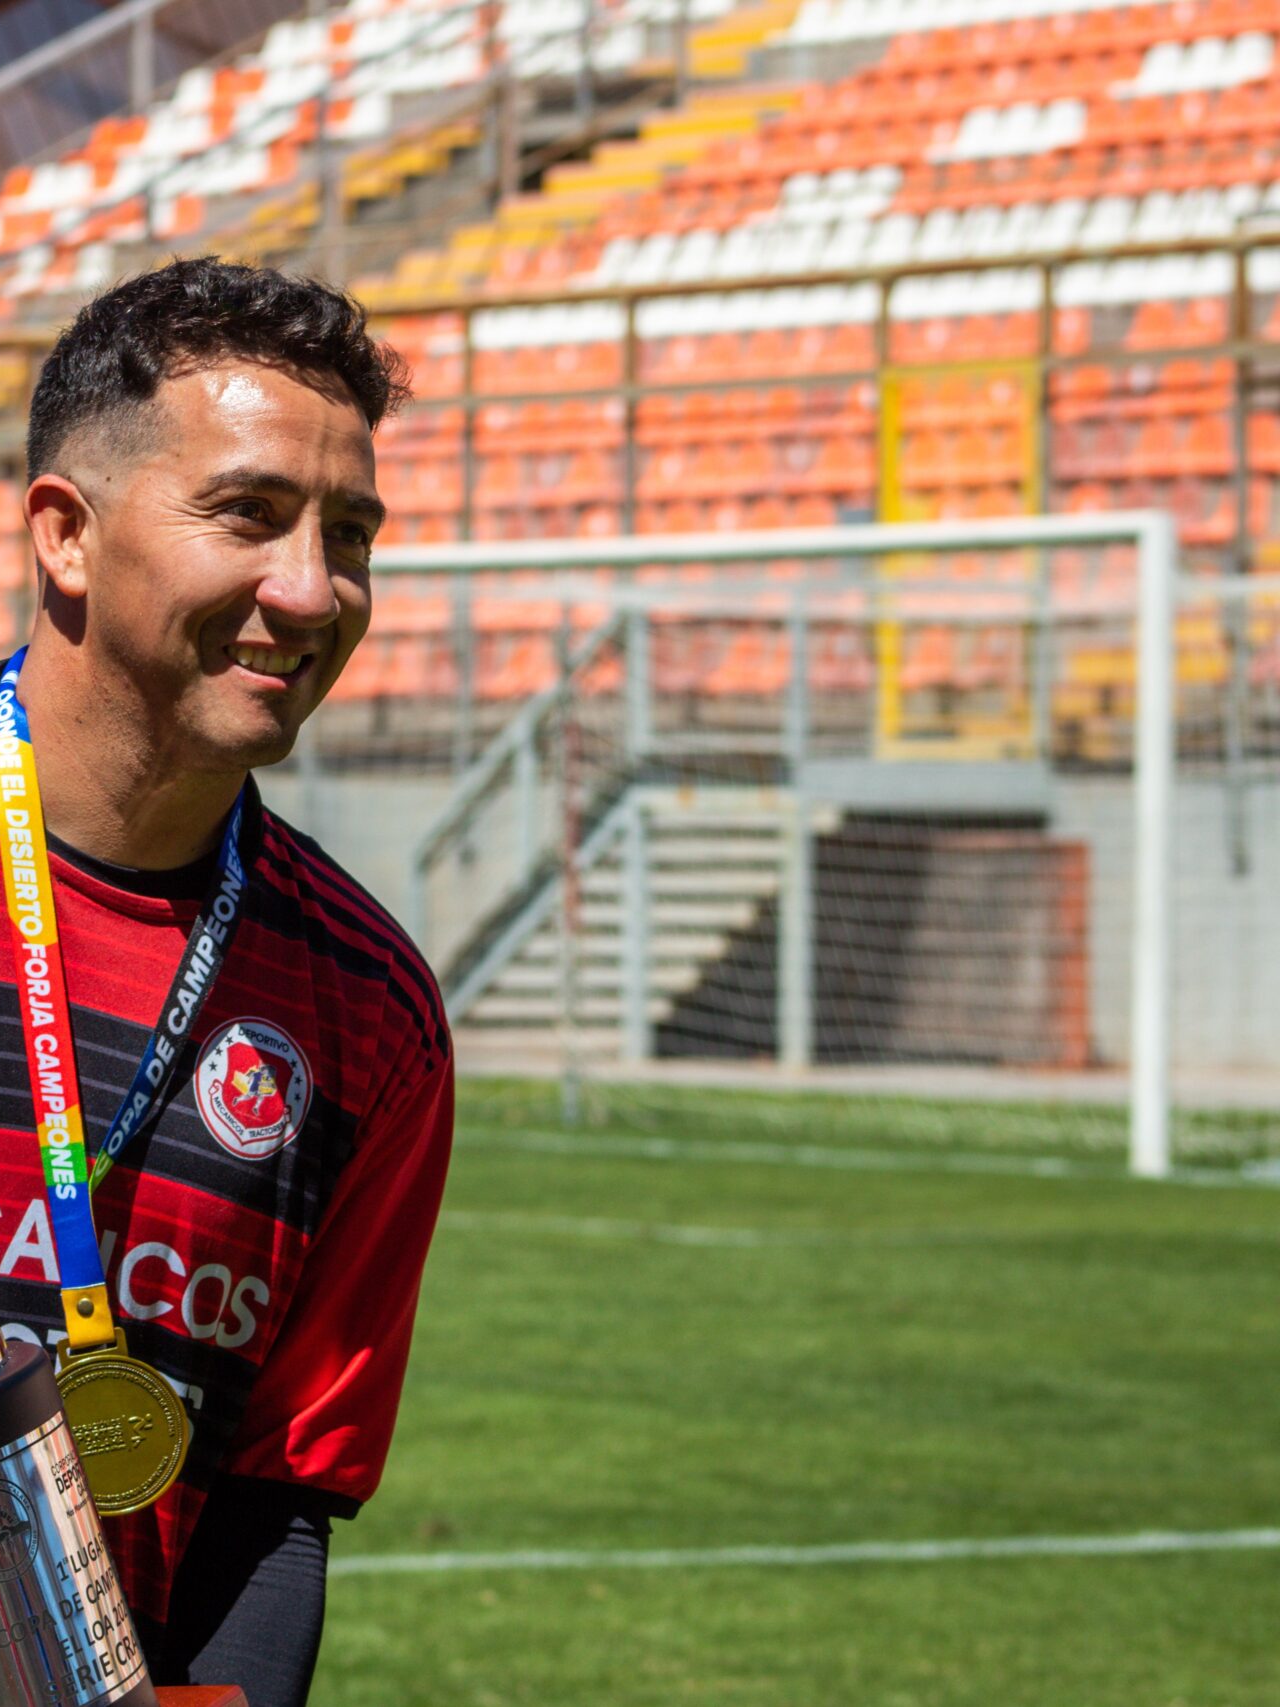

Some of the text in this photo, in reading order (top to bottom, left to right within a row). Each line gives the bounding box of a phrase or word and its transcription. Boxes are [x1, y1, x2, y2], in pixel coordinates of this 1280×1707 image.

[0, 774, 26, 802] EL
[4, 808, 44, 937] DESIERTO
[21, 942, 55, 1028] FORJA
[238, 1027, 290, 1054] DEPORTIVO
[33, 1034, 77, 1200] CAMPEONES
[94, 1091, 151, 1178] COPA
[145, 1034, 175, 1089] DE
[213, 1096, 246, 1136] MECANICOS
[58, 1592, 85, 1621] DE
[58, 1636, 84, 1661] EL
[84, 1615, 115, 1647] LOA
